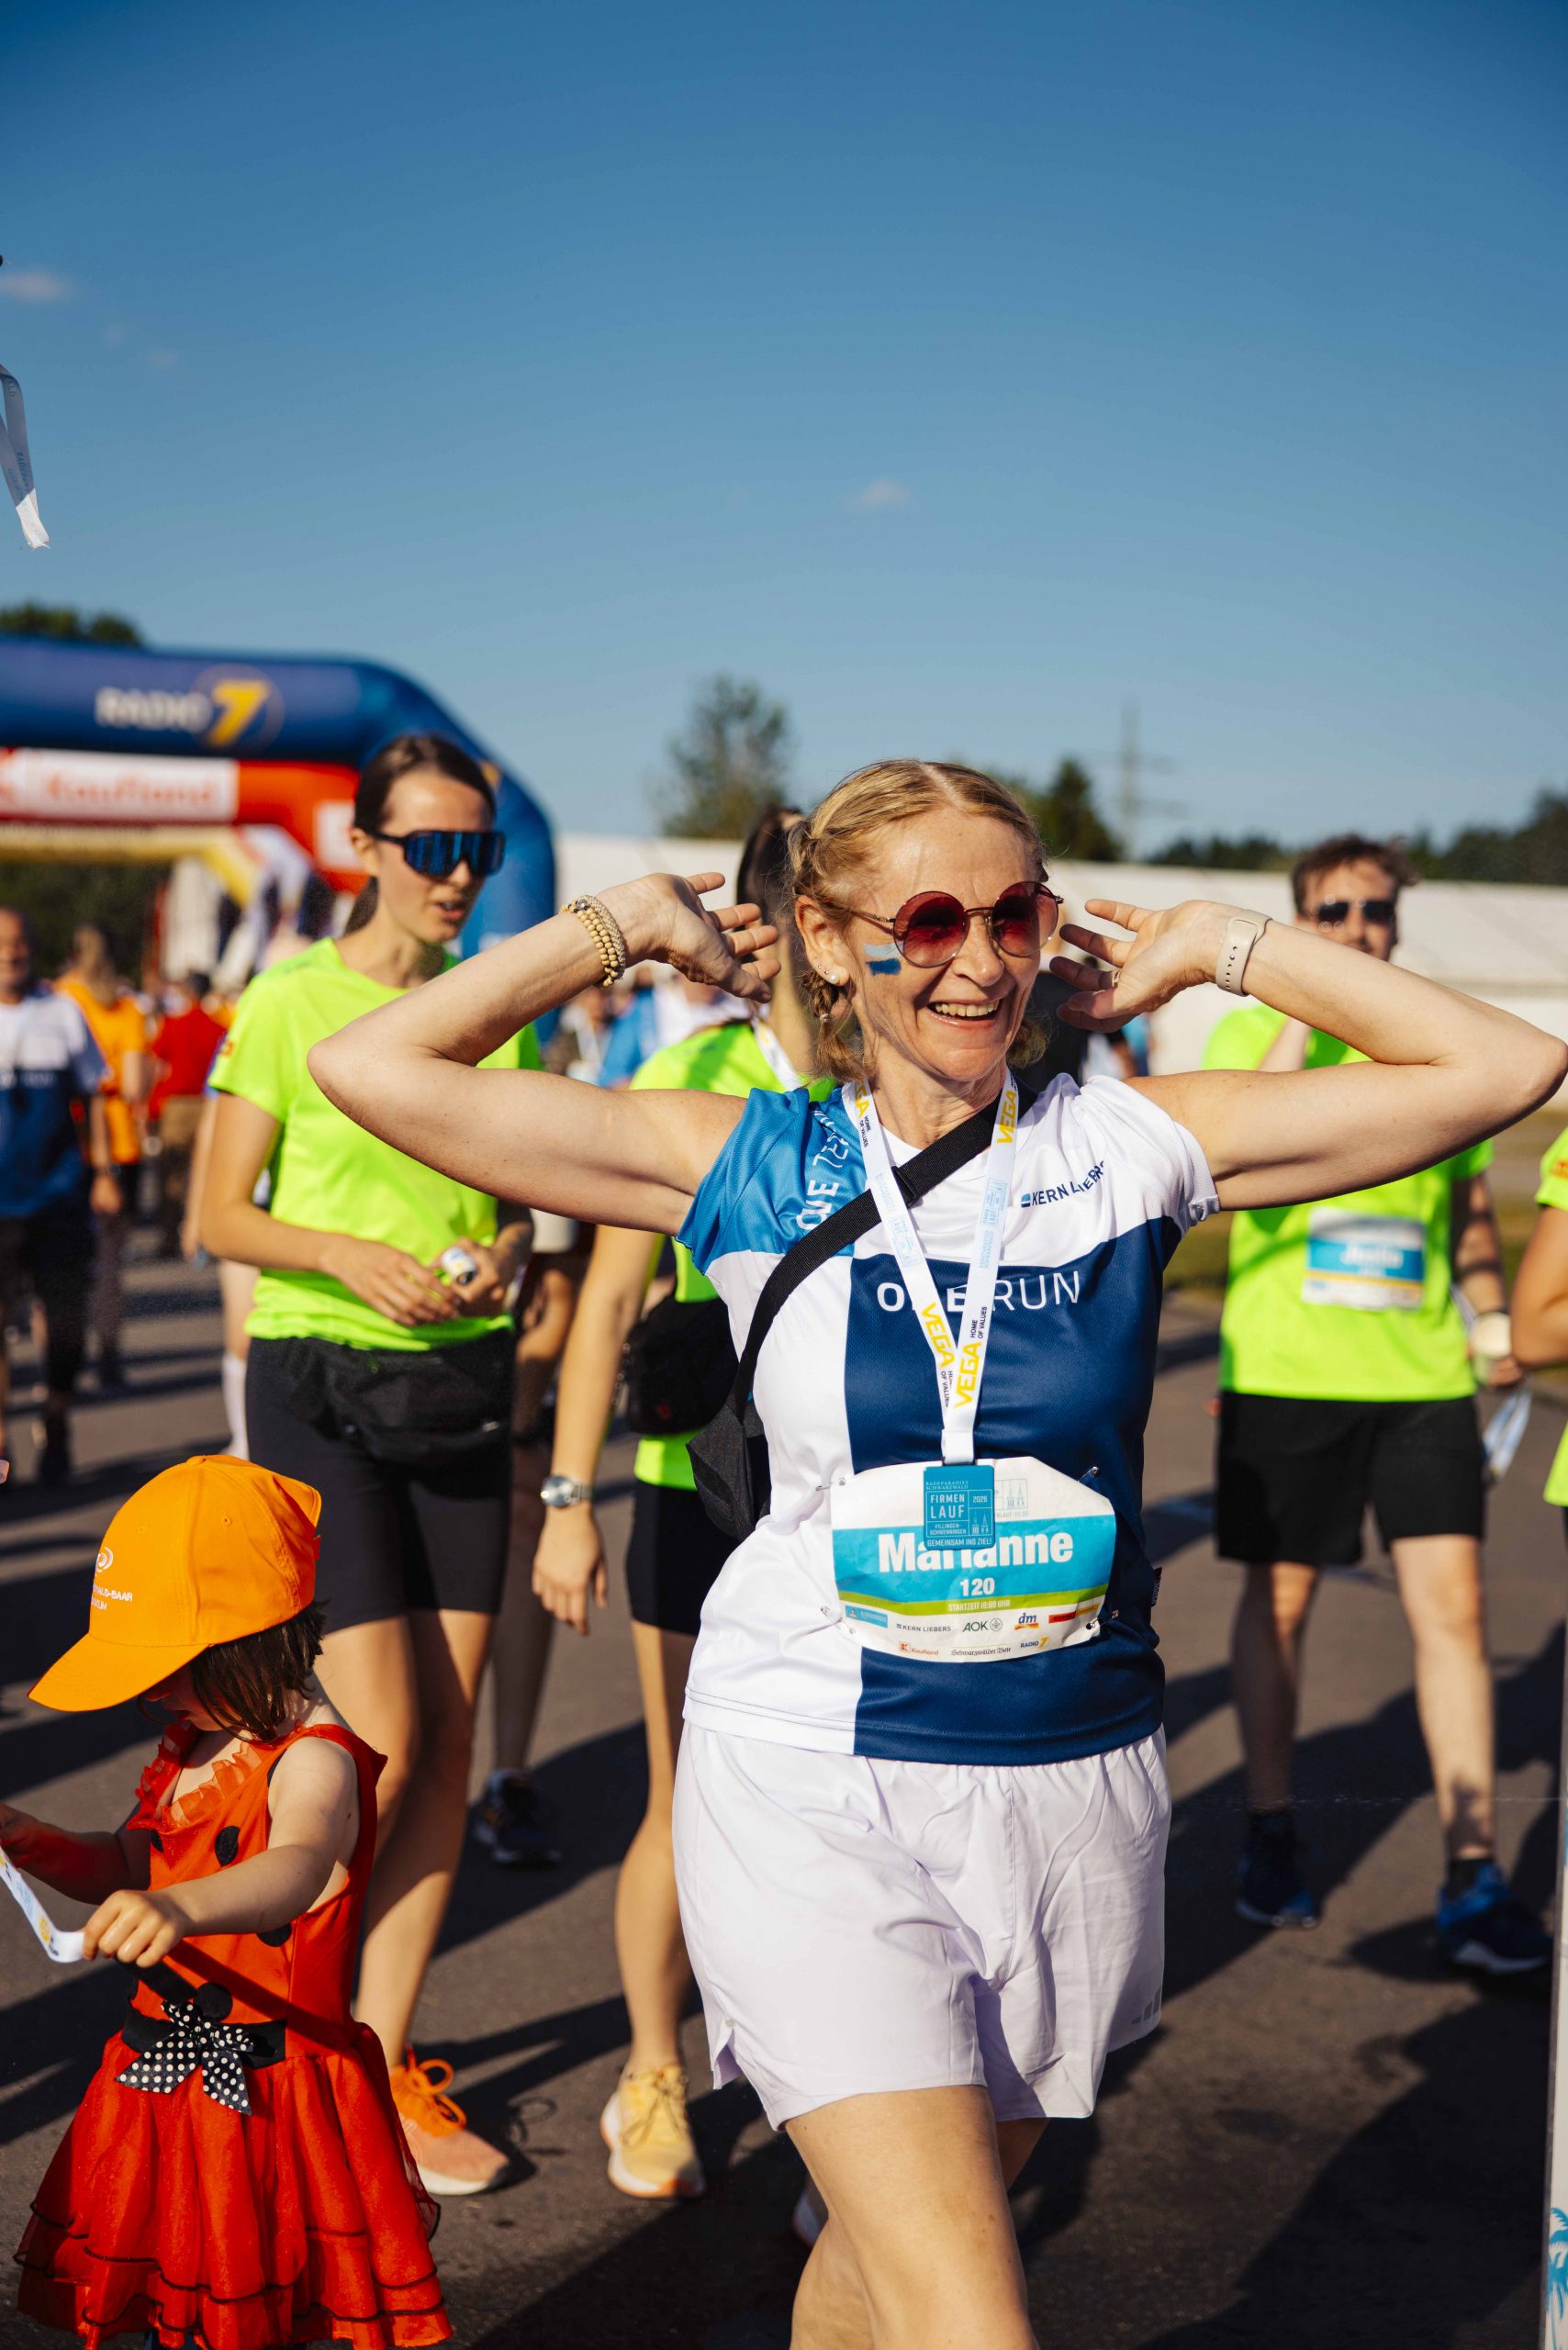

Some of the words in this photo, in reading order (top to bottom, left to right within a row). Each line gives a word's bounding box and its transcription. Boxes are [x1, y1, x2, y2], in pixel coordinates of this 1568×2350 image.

[95, 688, 212, 733] RADIO
[210, 679, 268, 745] 7
[996, 1090, 1017, 1144] VEGA
[1032, 1184, 1070, 1205] KERN
[795, 1180, 840, 1231] ONE
[877, 1281, 968, 1313] OE
[992, 1270, 1081, 1311] RUN
[979, 1306, 988, 1329] VALUES
[921, 1302, 956, 1370] VEGA
[969, 1319, 978, 1338] HOME
[978, 1330, 984, 1339] OF
[941, 1371, 947, 1381] OF
[953, 1341, 982, 1409] VEGA
[930, 1494, 965, 1504] FIRMEN
[930, 1505, 965, 1519] LAUF
[927, 1539, 965, 1547] GEMEINSAM
[966, 1538, 976, 1546] INS
[959, 1577, 995, 1596] 120
[947, 1603, 980, 1612] STARTZEIT
[1018, 1612, 1036, 1624] dm
[962, 1621, 989, 1632] AOK
[1020, 1640, 1039, 1649] RADIO
[1038, 1635, 1049, 1649] 7
[911, 1647, 939, 1656] Kaufland
